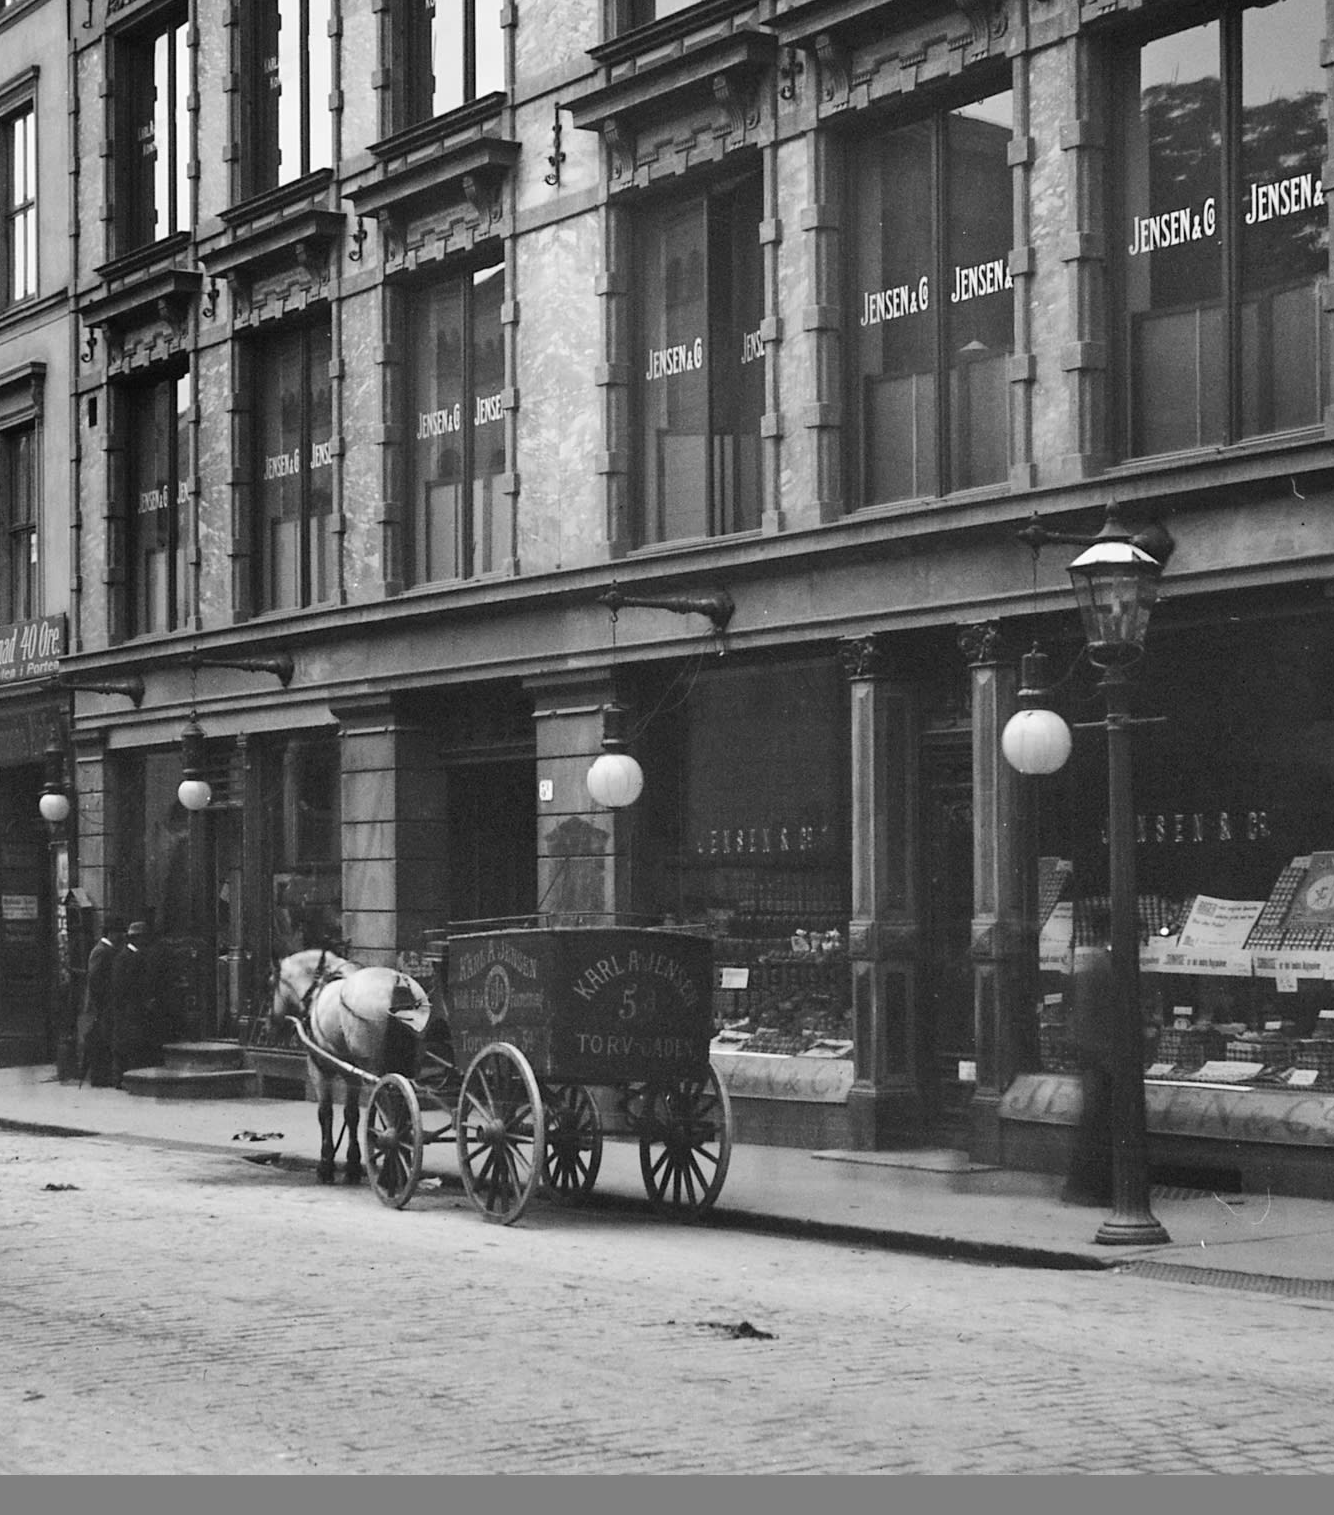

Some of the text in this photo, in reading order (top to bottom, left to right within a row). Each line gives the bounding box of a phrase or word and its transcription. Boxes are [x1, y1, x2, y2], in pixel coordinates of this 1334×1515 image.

[1245, 173, 1325, 225] JENSEN &
[1128, 207, 1191, 256] JENSEN
[1192, 214, 1202, 240] &
[951, 259, 1014, 303] JENSEN &
[860, 285, 909, 327] JENSEN
[909, 292, 918, 313] &
[646, 347, 687, 381] JENSEN
[687, 350, 694, 371] &
[417, 409, 448, 440] JENSEN
[264, 454, 289, 480] JENSEN
[310, 442, 333, 470] JENS
[20, 624, 38, 661] 40
[26, 660, 60, 675] Porten
[573, 955, 625, 1000] KARL
[618, 983, 637, 1019] 5
